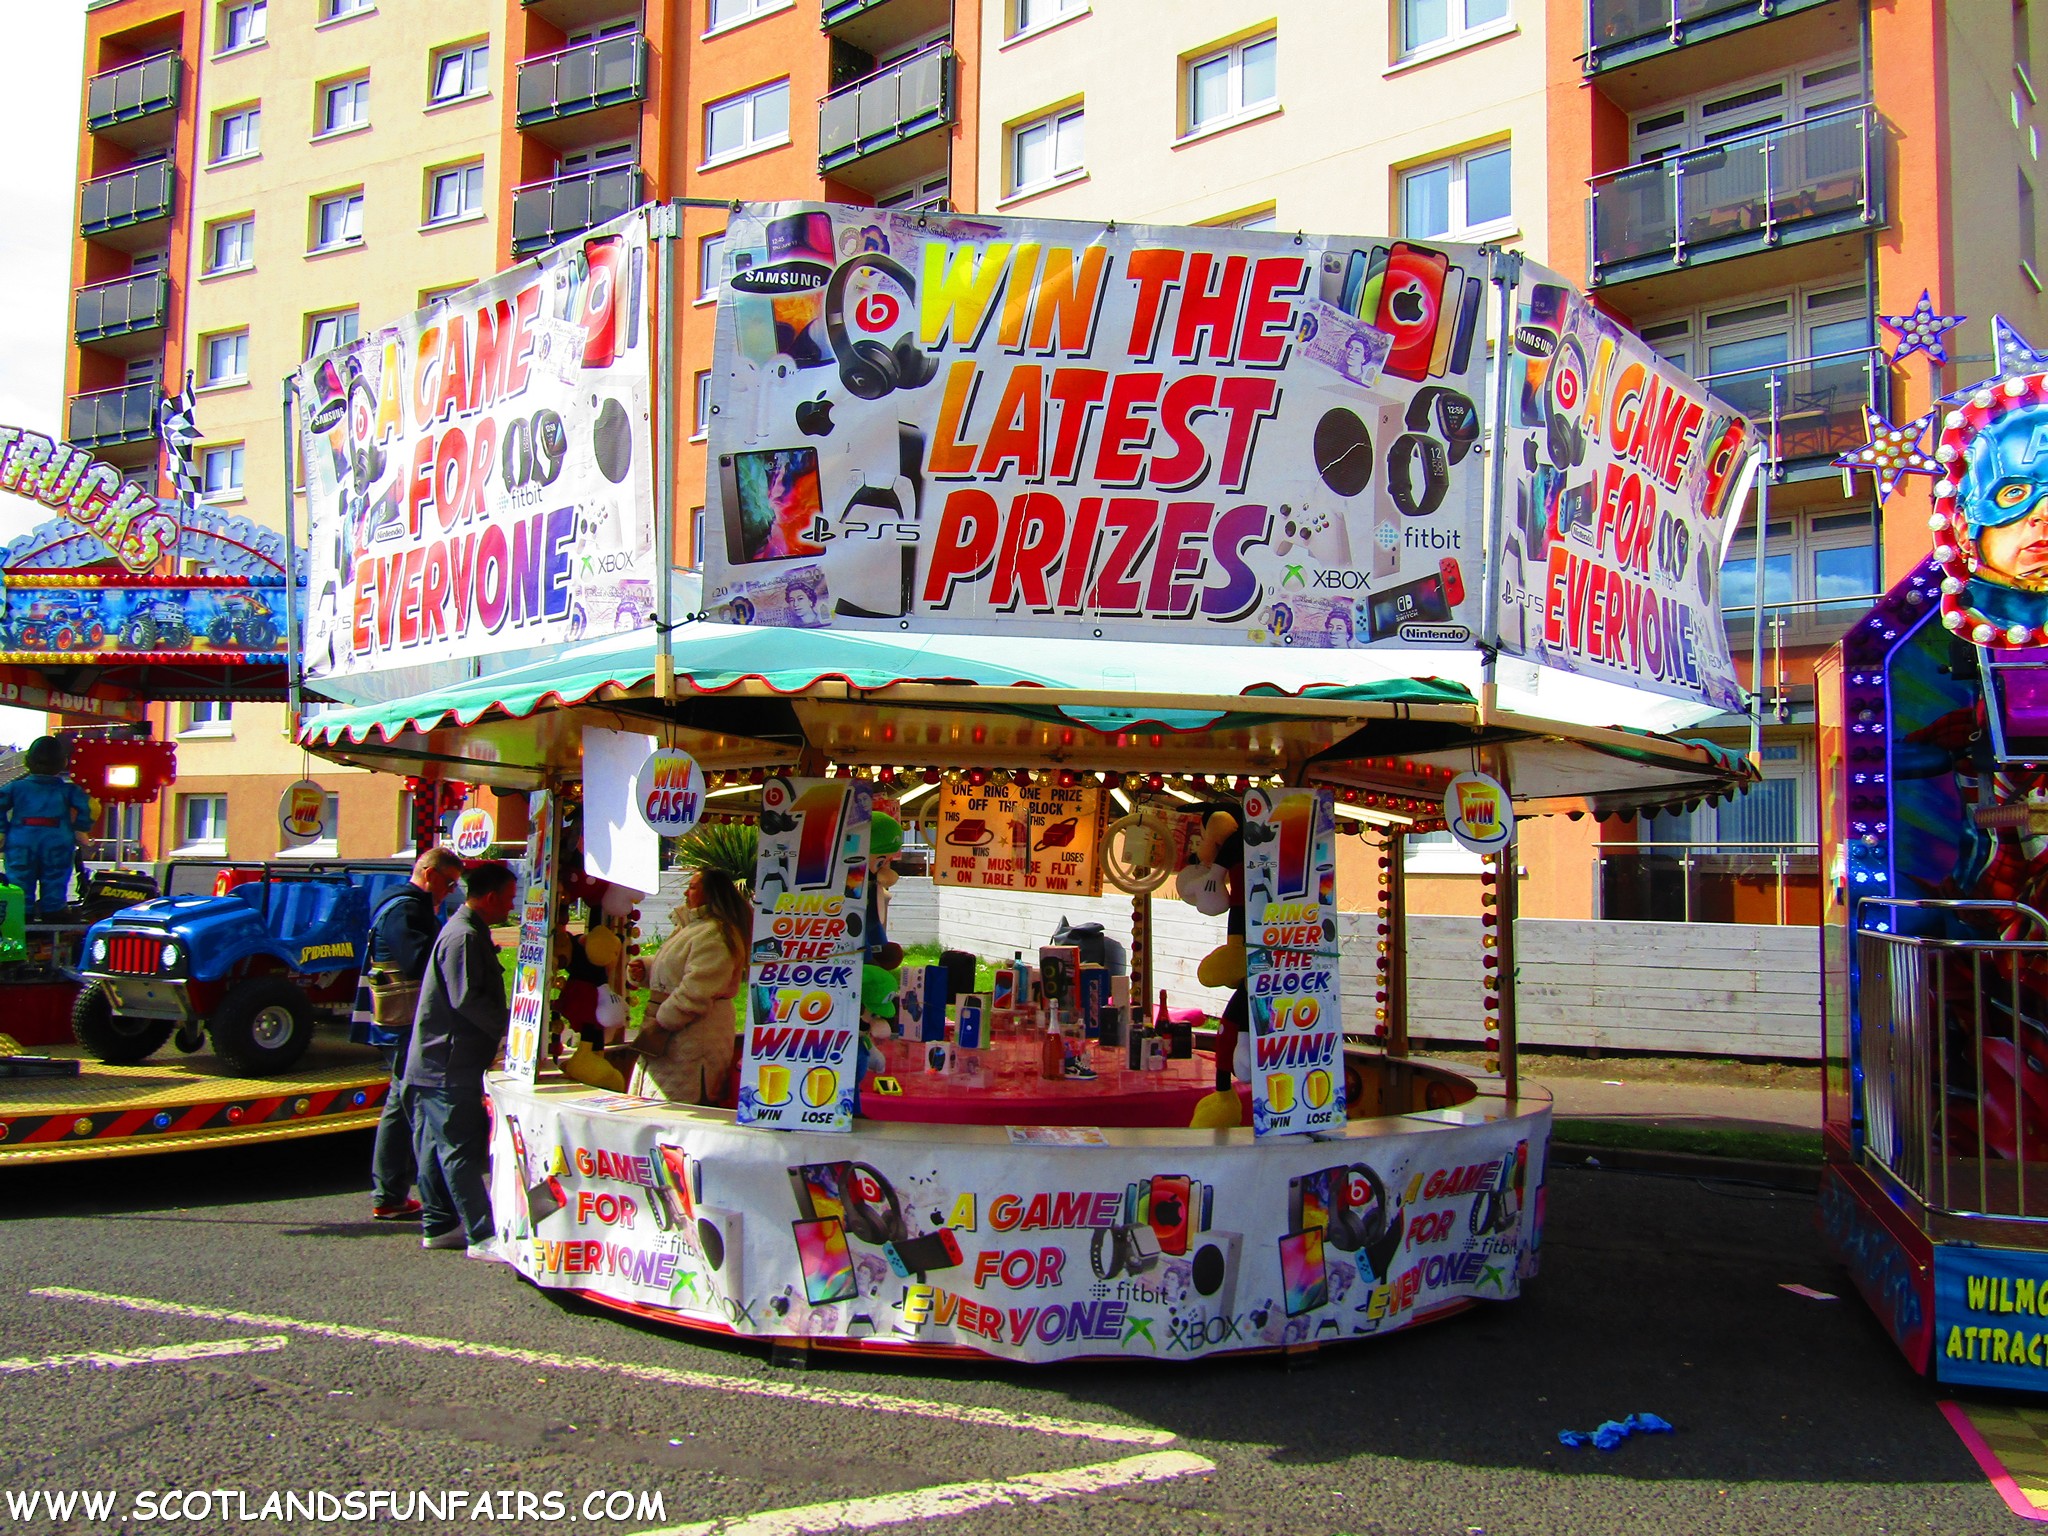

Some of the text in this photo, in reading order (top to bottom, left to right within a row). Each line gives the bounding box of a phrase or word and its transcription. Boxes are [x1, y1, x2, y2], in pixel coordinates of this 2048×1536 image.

[745, 270, 821, 288] SAMSUNG
[920, 243, 1310, 371] WIN THE
[376, 285, 541, 444] A GAME
[315, 407, 345, 426] SAMSUNG
[1447, 406, 1464, 415] 12:58
[1582, 338, 1704, 494] A GAME
[928, 361, 1282, 496] LATEST
[1431, 447, 1442, 459] 12
[410, 416, 498, 539] FOR
[511, 485, 543, 510] fitbit
[377, 527, 403, 540] Nintendo
[844, 521, 921, 542] PS5
[1597, 463, 1660, 583] FOR
[1404, 526, 1461, 549] fitbit
[597, 550, 634, 575] XBOX
[923, 488, 1274, 622] PRIZES
[354, 507, 579, 655] EVERYONE
[1312, 569, 1372, 590] XBOX
[1516, 588, 1544, 614] PS5
[1545, 541, 1703, 690] EVERYONE
[1406, 627, 1465, 641] Nintendo
[50, 691, 100, 713] ADULT
[654, 757, 693, 790] WIN
[952, 784, 1083, 802] ONE RING ONE PRIZE
[294, 804, 319, 822] WIN
[646, 790, 698, 824] CASH
[945, 812, 960, 822] THIS
[968, 799, 988, 811] OFF
[1029, 802, 1063, 815] BLOCK
[1464, 798, 1496, 825] WIN
[462, 813, 486, 831] WIN
[1030, 816, 1046, 826] THIS
[458, 830, 489, 850] CASH
[790, 782, 851, 891] 1
[1268, 792, 1318, 901] 1
[972, 847, 989, 857] WINS
[1061, 852, 1085, 863] LOSES
[950, 855, 976, 869] RING
[987, 858, 1015, 872] MUS
[1051, 863, 1078, 876] FLAT
[957, 870, 1069, 890] ON TABLE TO WIN
[100, 886, 147, 900] BATMAN
[774, 893, 846, 917] RING
[1263, 902, 1321, 926] RING
[772, 917, 848, 941] OVER
[1262, 925, 1322, 948] OVER
[300, 942, 354, 964] SPIDER-MAN
[519, 944, 545, 964] BLOCK
[783, 940, 837, 964] THE
[1272, 949, 1314, 971] THE
[758, 962, 853, 989] BLOCK
[1255, 970, 1332, 998] BLOCK
[513, 995, 540, 1027] WIN!
[775, 989, 834, 1025] TO
[1272, 996, 1321, 1032] TO
[750, 1026, 853, 1065] WIN!
[1256, 1032, 1337, 1070] WIN!
[756, 1108, 835, 1125] WIN LOSE
[1270, 1111, 1332, 1129] WIN LOSE
[550, 1144, 653, 1187] A GAME
[1401, 1160, 1503, 1204] A GAME
[577, 1191, 636, 1229] FOR
[946, 1191, 1122, 1232] A GAME
[1406, 1209, 1456, 1252] FOR
[1482, 1236, 1519, 1255] fitbit
[532, 1237, 679, 1291] EVERYONE
[973, 1246, 1066, 1290] FOR
[1116, 1281, 1169, 1306] fitbit
[903, 1284, 1129, 1347] EVERYONE
[1166, 1313, 1244, 1353] XBOX
